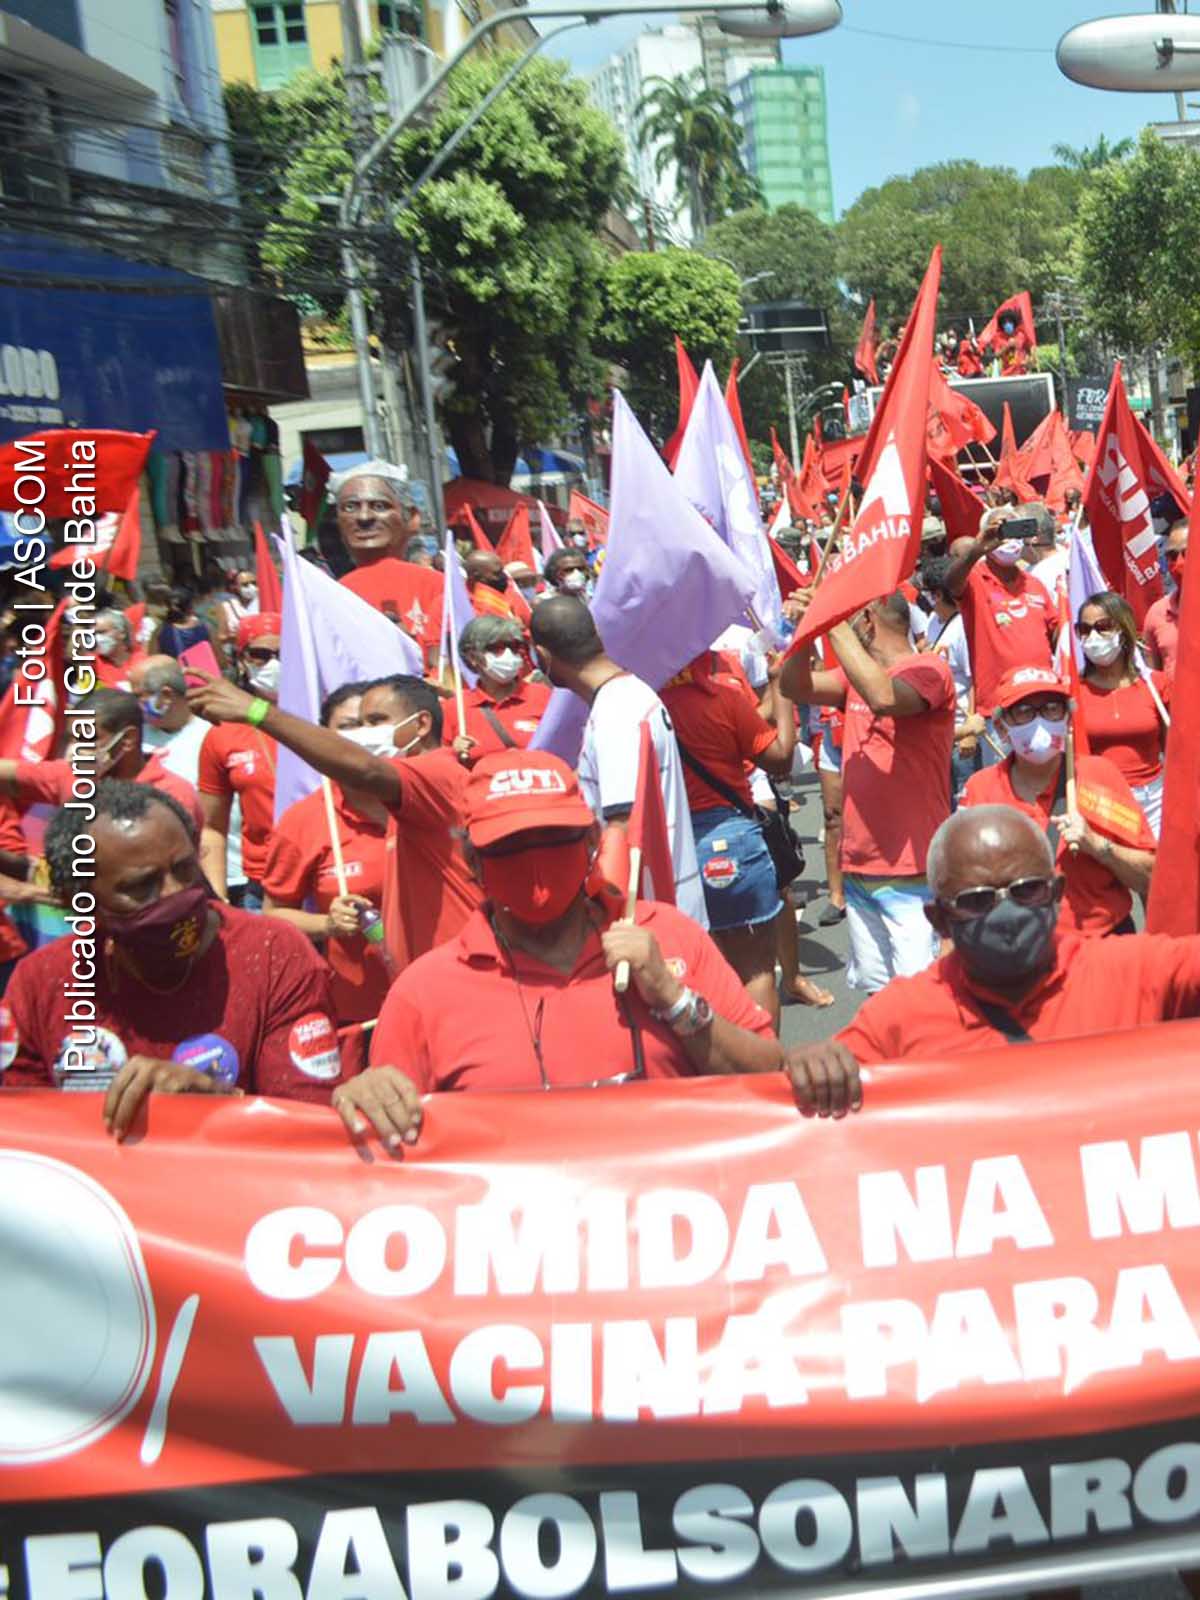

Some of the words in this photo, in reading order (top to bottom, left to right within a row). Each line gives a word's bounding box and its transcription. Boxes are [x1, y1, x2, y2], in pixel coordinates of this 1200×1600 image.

[844, 517, 911, 563] BAHIA
[488, 768, 553, 793] CUT
[244, 1182, 829, 1301] COMIDA
[858, 1154, 1055, 1270] NA
[254, 1313, 809, 1426] VACINA
